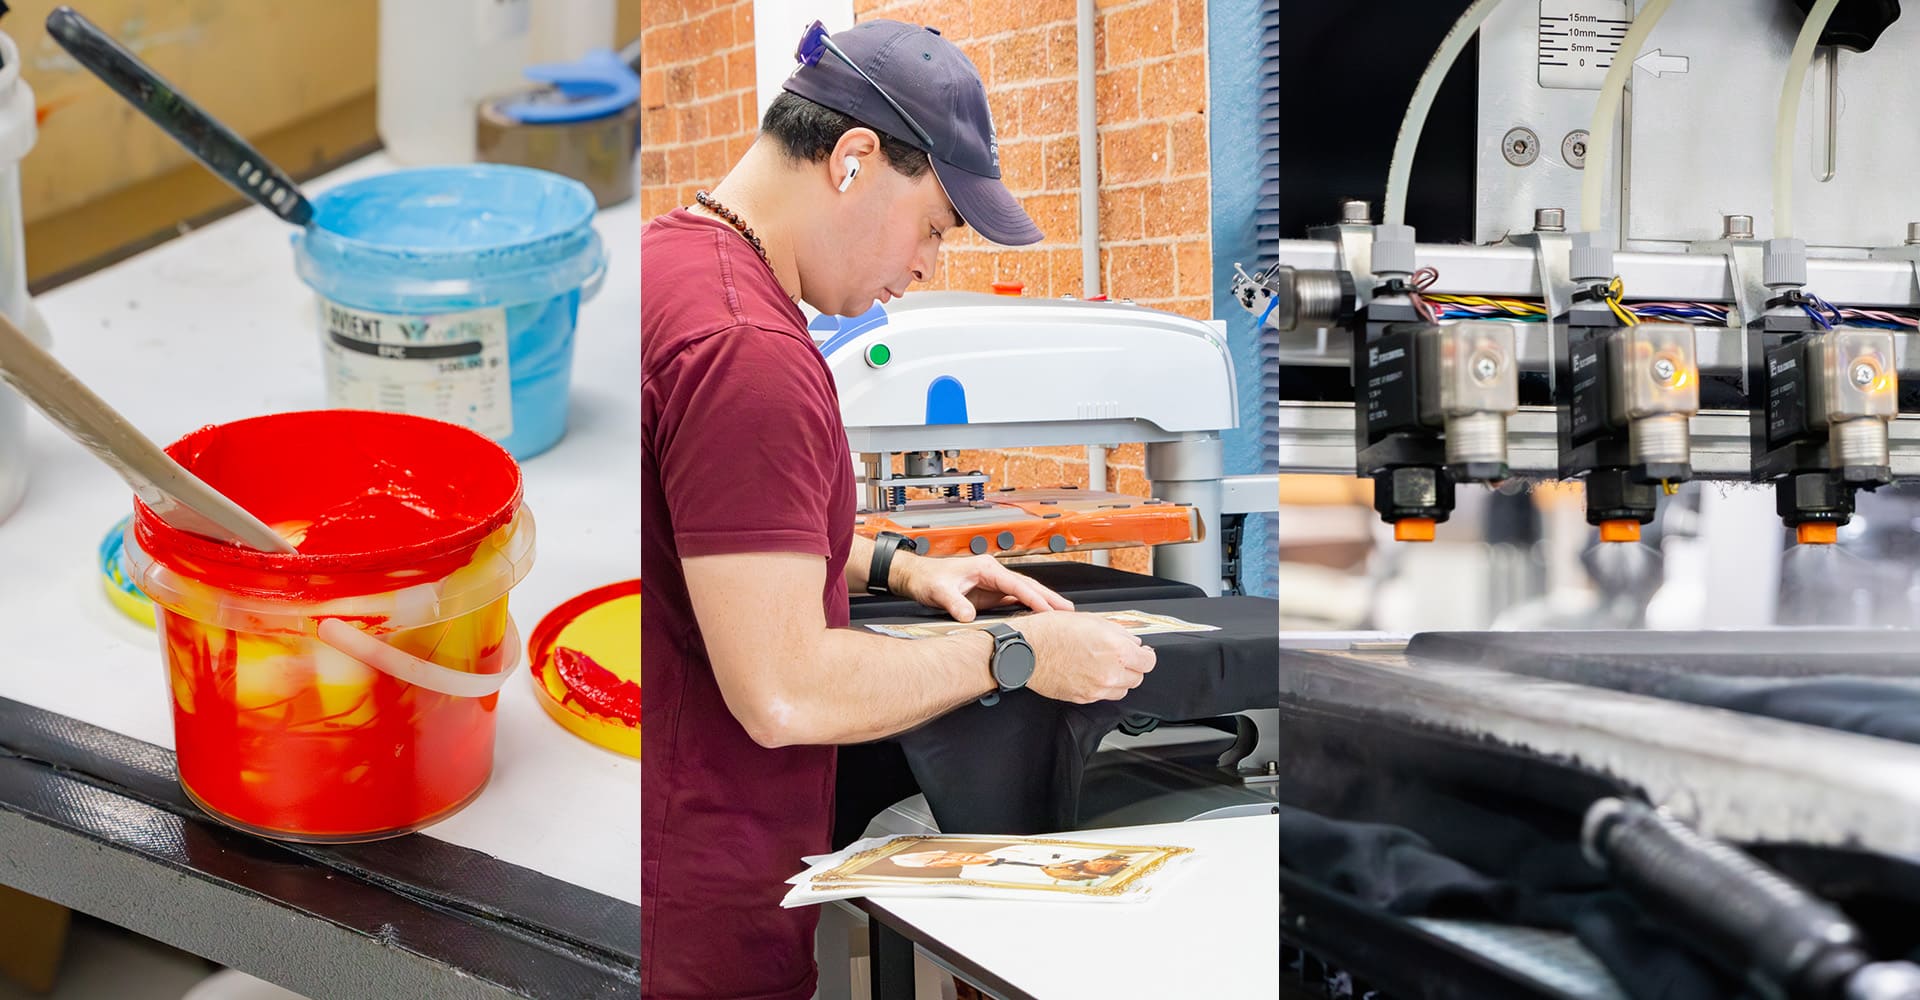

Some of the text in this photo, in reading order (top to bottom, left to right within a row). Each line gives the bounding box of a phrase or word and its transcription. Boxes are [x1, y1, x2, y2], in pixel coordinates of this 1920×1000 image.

[1569, 13, 1597, 22] 15mm
[1568, 28, 1597, 38] 10mm
[1571, 43, 1594, 53] 5mm
[1579, 58, 1585, 67] 0
